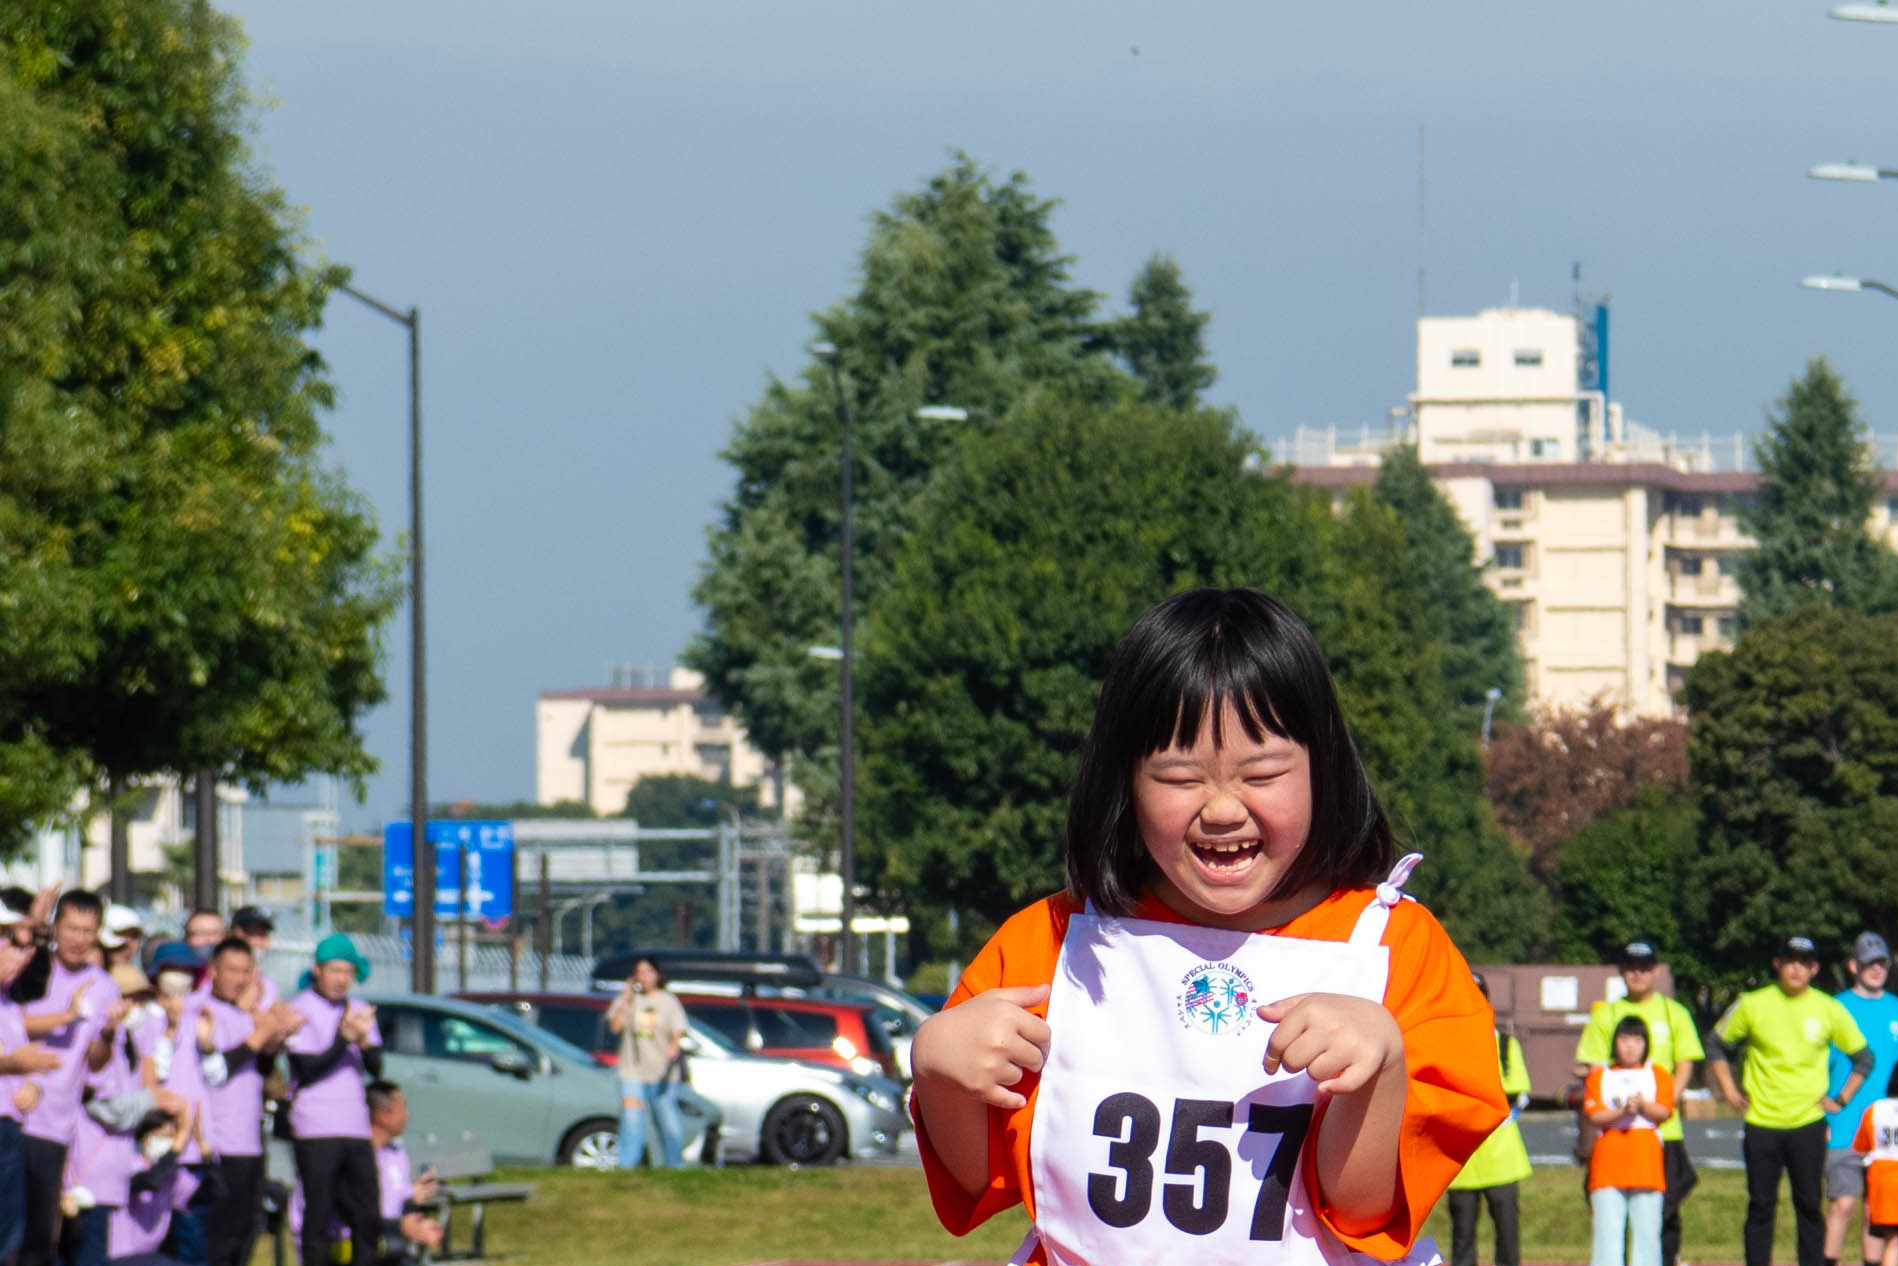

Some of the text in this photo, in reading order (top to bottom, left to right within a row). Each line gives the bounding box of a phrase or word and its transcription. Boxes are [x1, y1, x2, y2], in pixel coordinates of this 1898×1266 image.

[1181, 962, 1255, 992] SPECIAL OLYMPICS
[1088, 1091, 1315, 1241] 357
